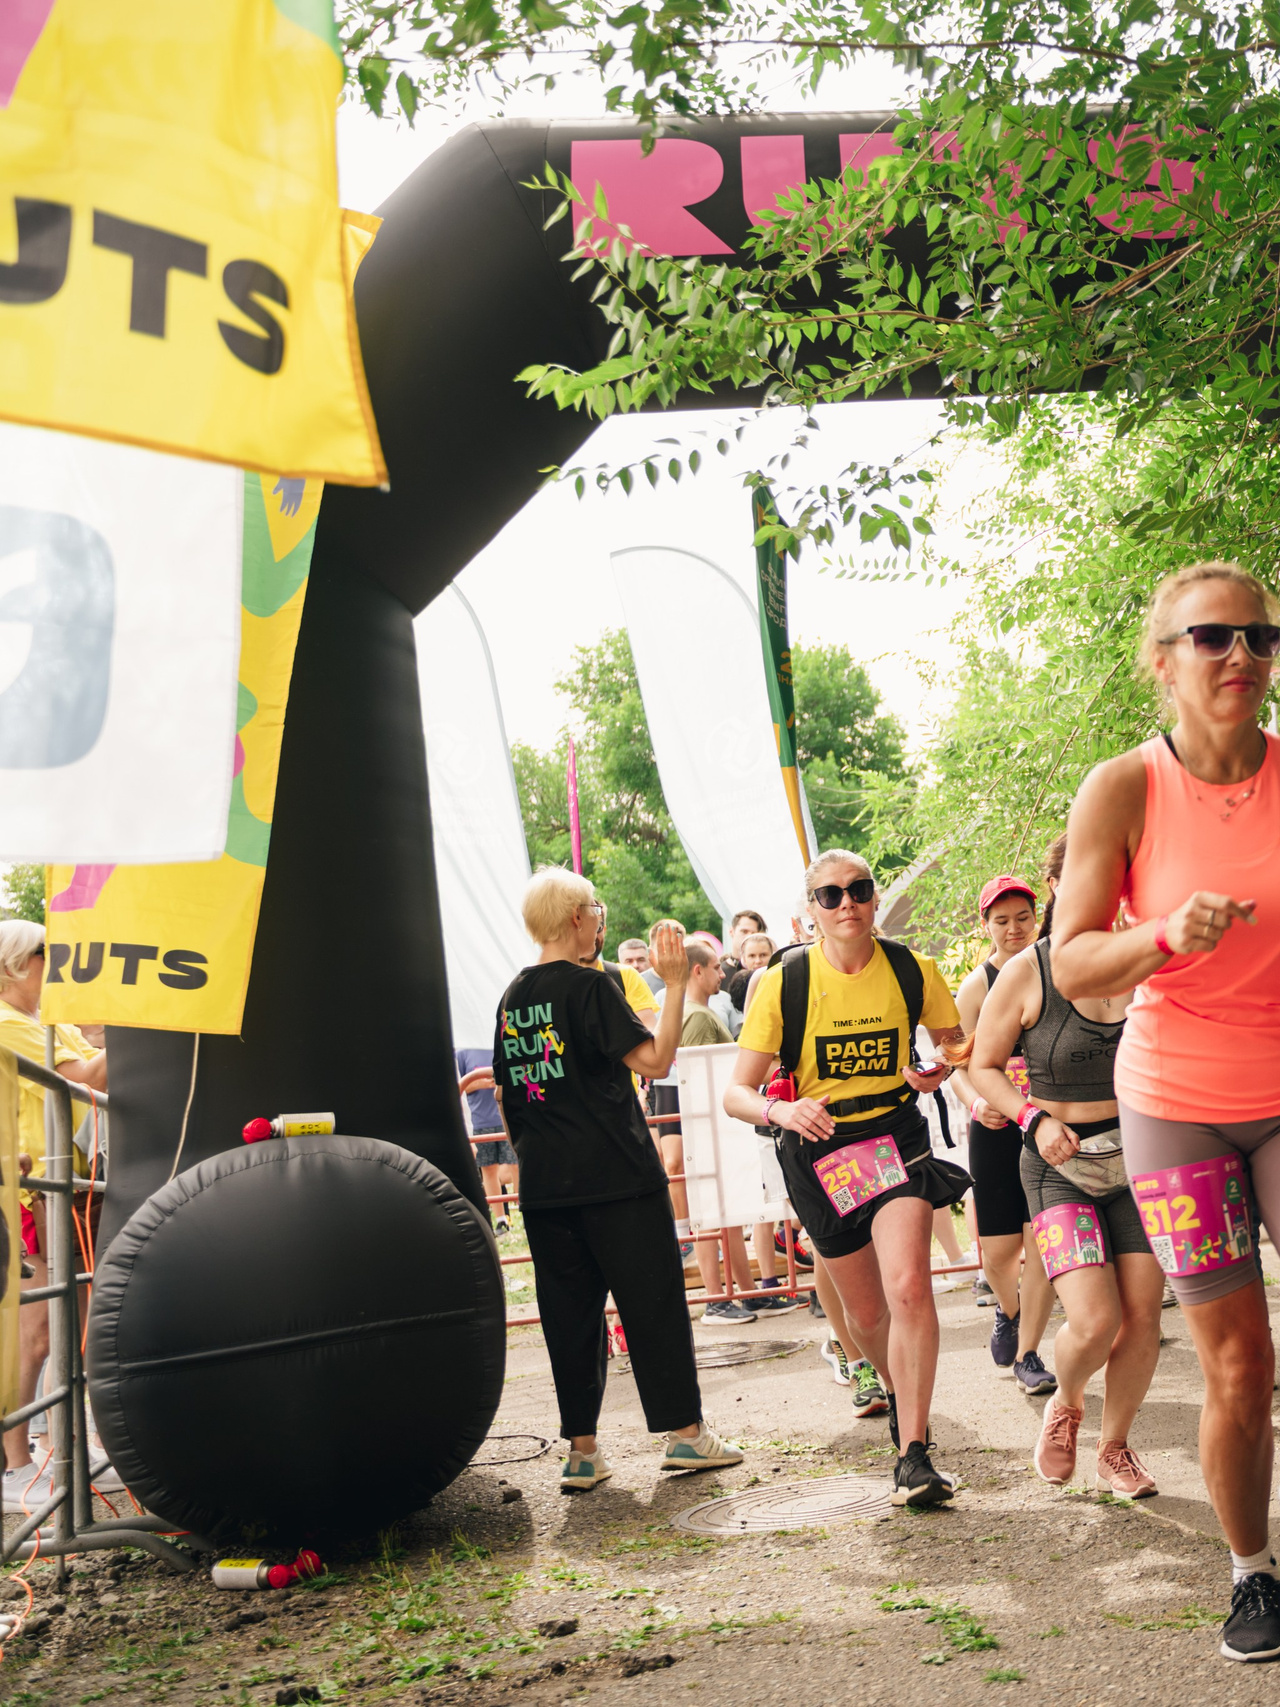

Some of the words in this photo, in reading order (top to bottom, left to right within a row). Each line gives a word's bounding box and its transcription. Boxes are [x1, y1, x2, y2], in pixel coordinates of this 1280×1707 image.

[46, 941, 209, 990] RUTS
[503, 1002, 553, 1031] RUN
[826, 1037, 891, 1060] PACE
[509, 1058, 565, 1087] RUN
[827, 1057, 889, 1075] TEAM
[823, 1159, 862, 1195] 251
[1140, 1195, 1201, 1235] 312
